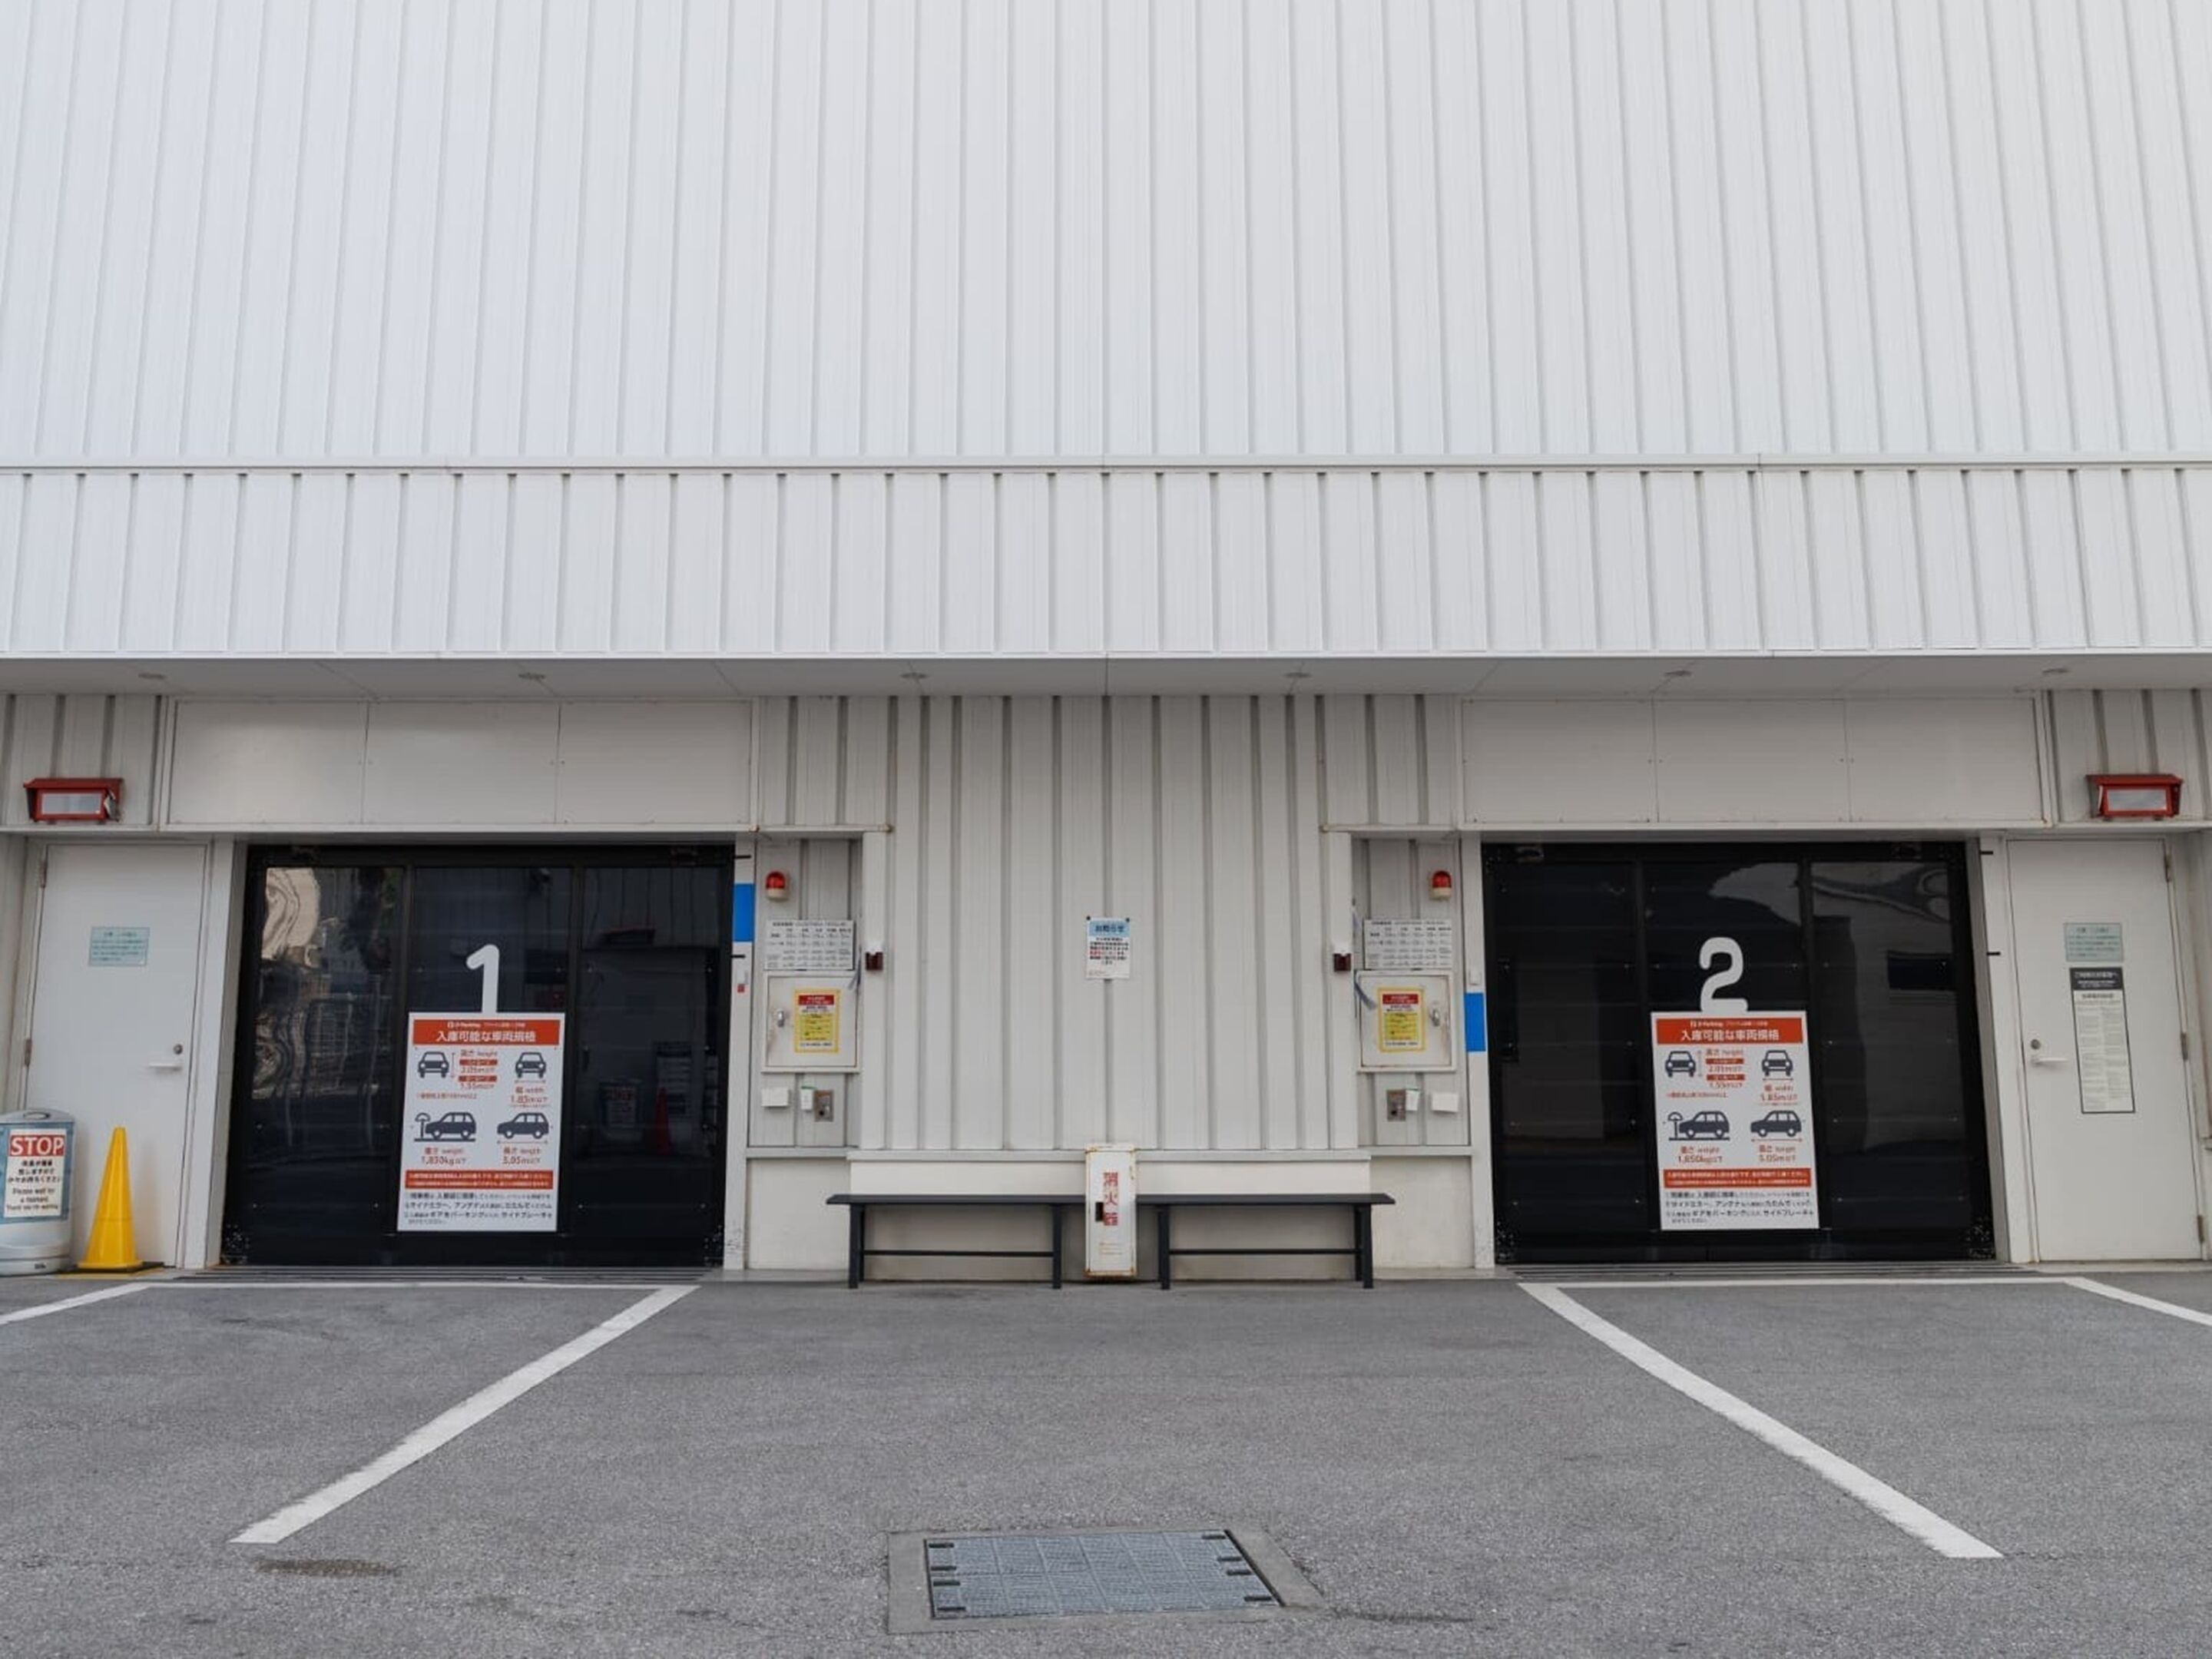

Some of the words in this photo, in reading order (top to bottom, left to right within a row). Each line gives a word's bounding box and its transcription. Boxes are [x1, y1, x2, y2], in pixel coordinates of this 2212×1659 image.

[466, 944, 499, 1013] 1
[1699, 937, 1748, 1012] 2
[11, 1137, 64, 1156] STOP
[1103, 1172, 1119, 1227] 消火器
